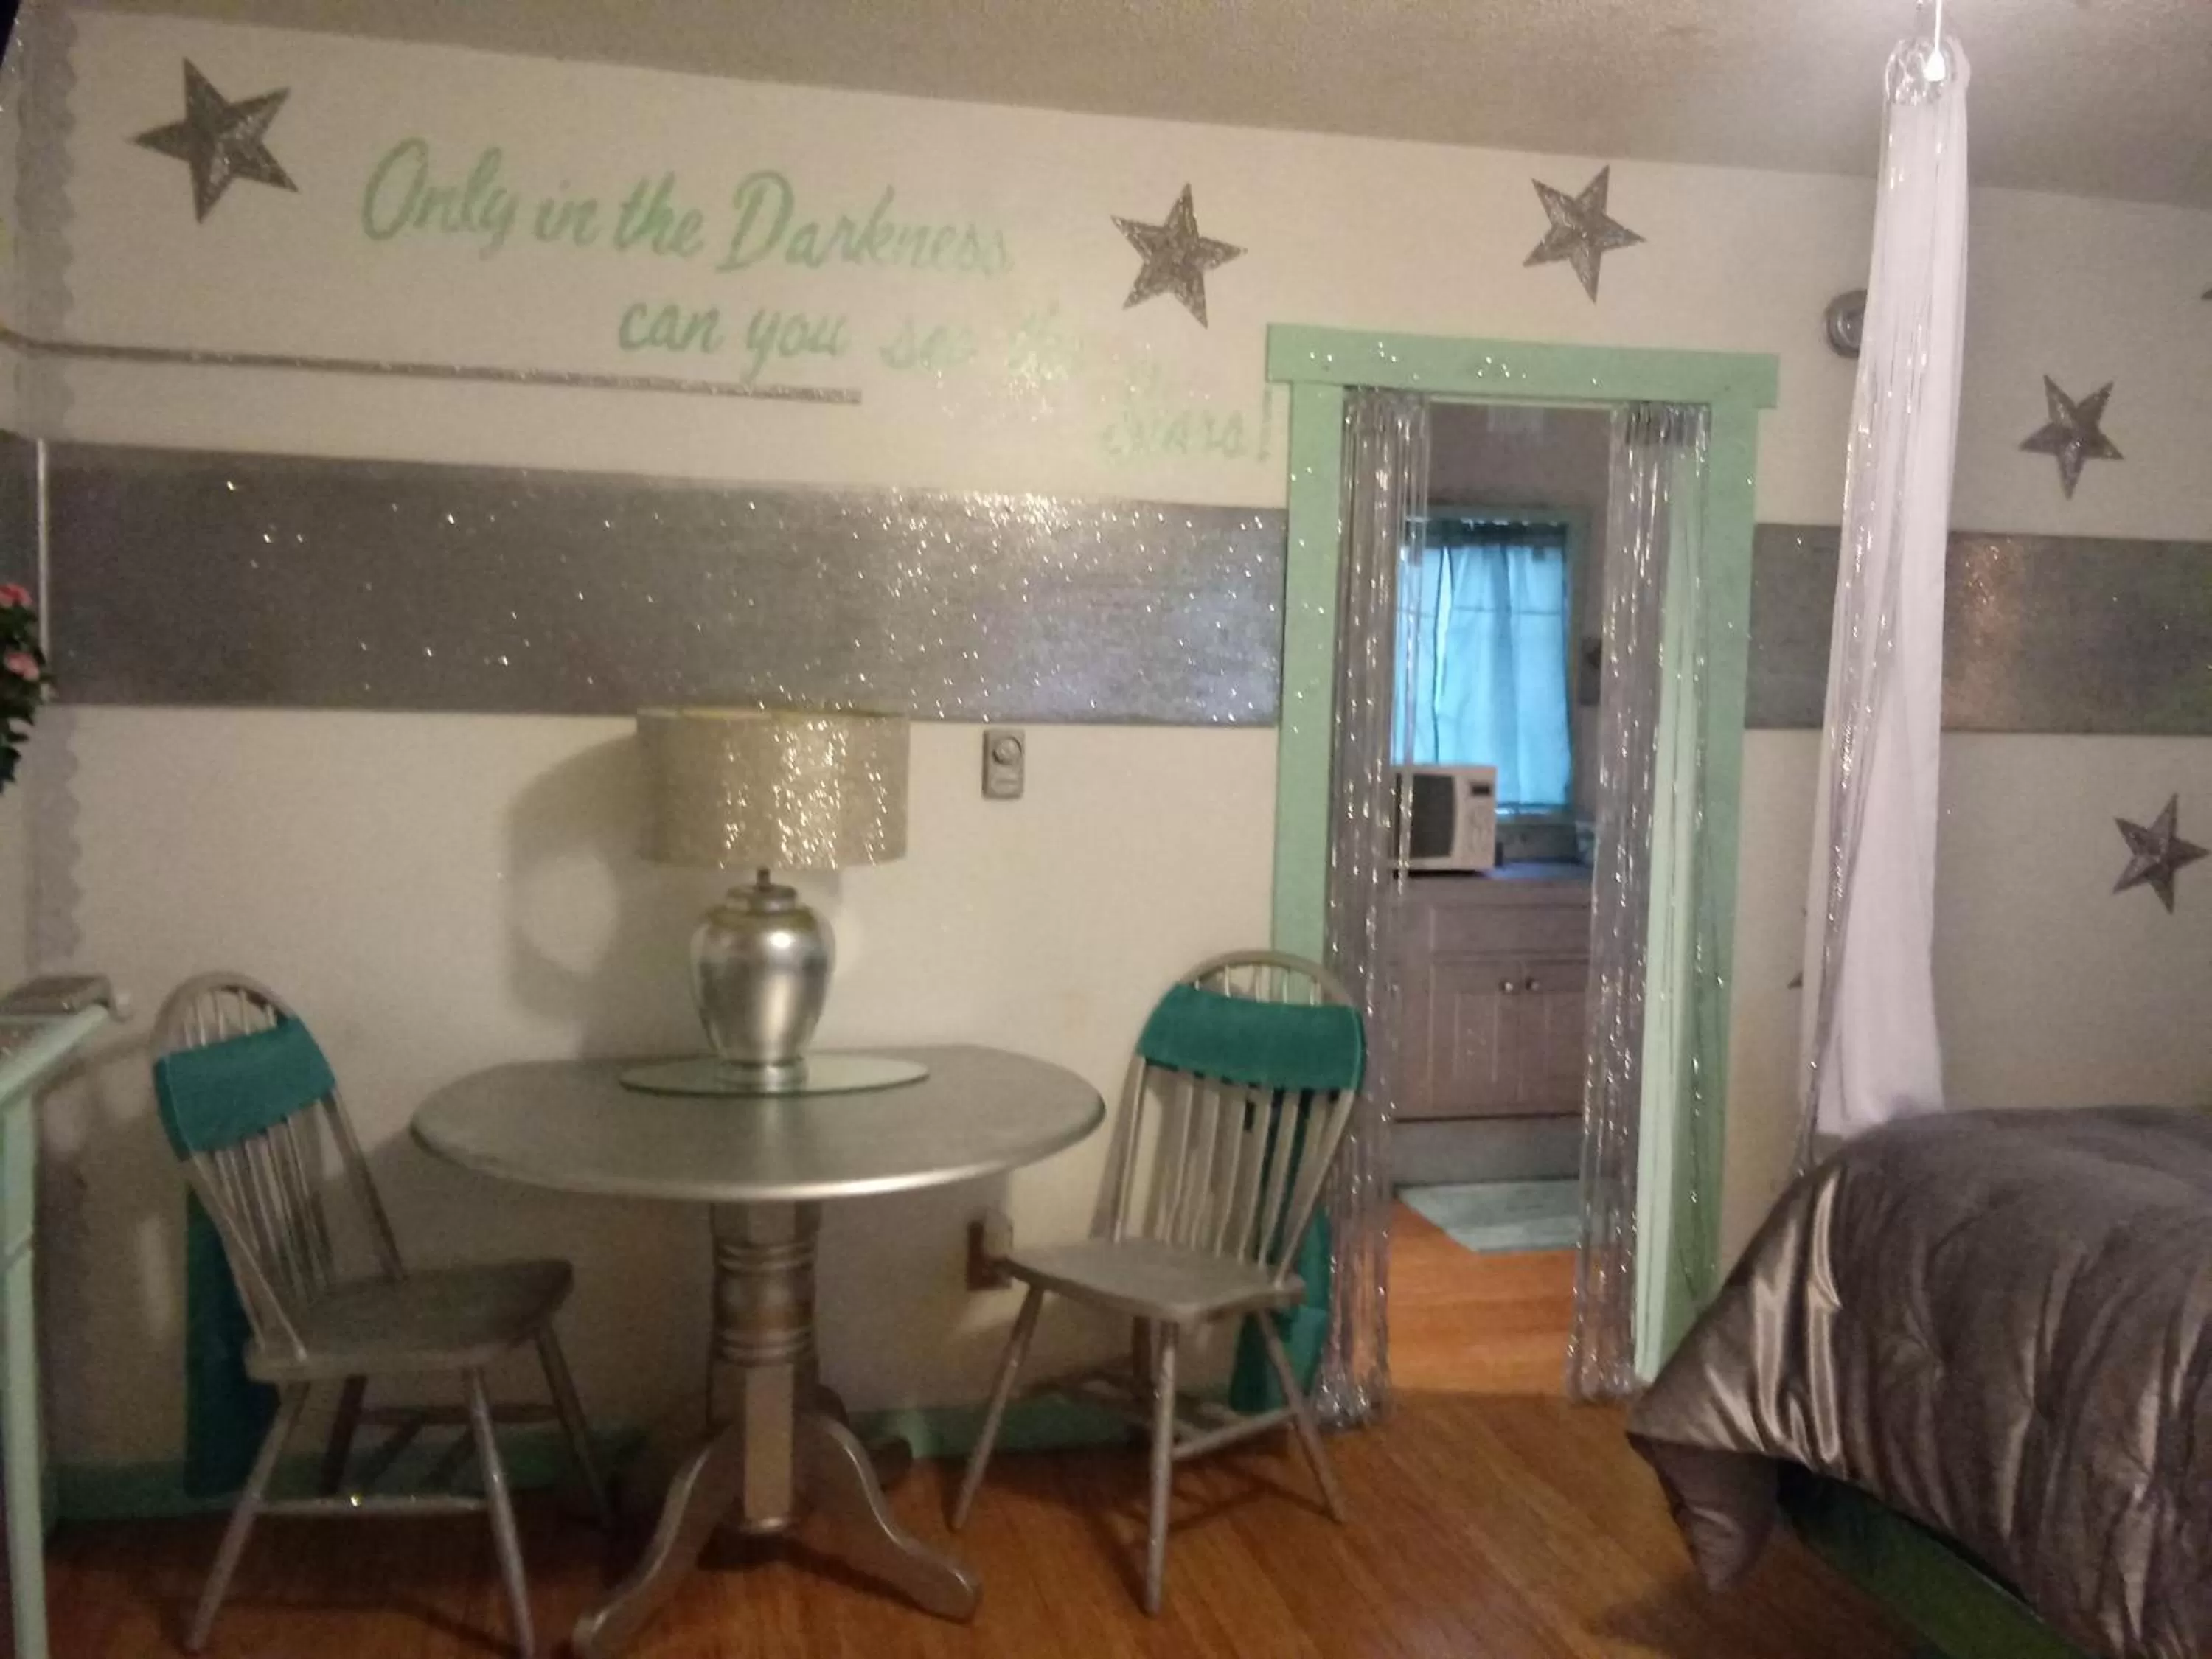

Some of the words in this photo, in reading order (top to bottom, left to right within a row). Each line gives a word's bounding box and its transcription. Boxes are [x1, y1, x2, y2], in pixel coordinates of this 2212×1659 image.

[363, 136, 514, 261] Only
[532, 178, 600, 242] in
[611, 171, 703, 257] the
[715, 170, 1014, 274] Darkness
[618, 302, 724, 354] can
[743, 306, 849, 388] you
